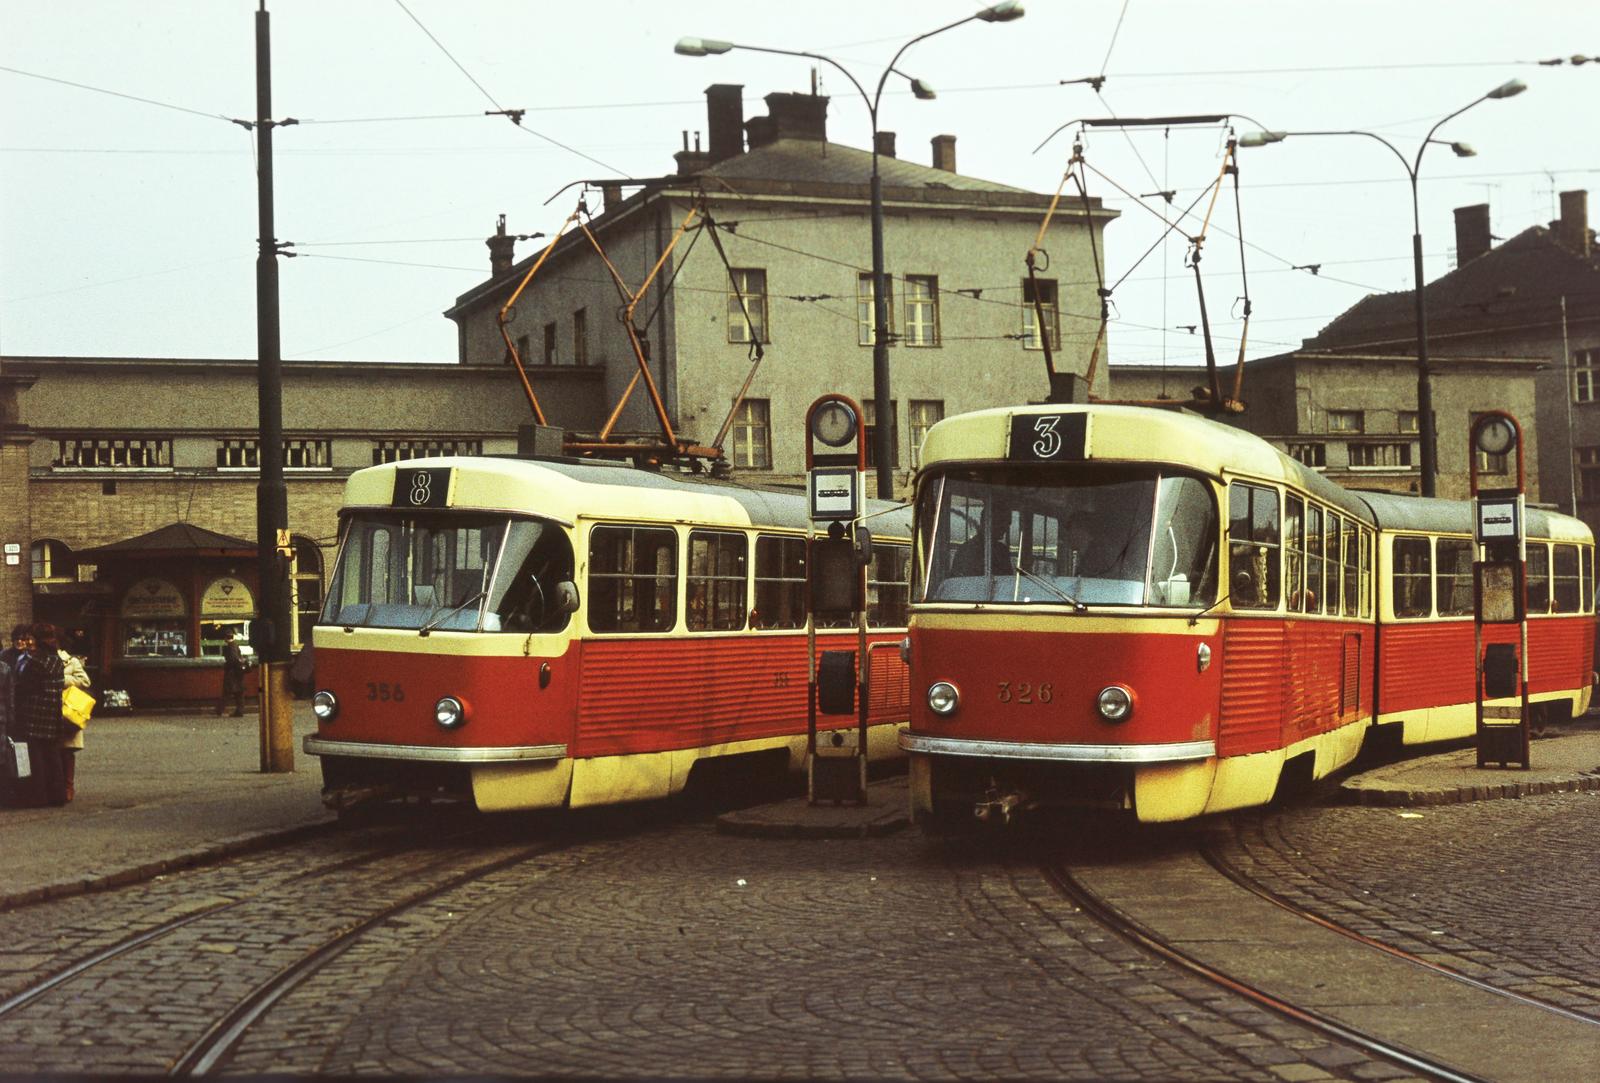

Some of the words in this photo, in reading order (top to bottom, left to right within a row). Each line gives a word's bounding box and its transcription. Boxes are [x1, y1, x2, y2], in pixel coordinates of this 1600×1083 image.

[1033, 415, 1061, 458] 3
[410, 470, 431, 505] 8
[367, 681, 404, 702] 356
[997, 681, 1053, 704] 326
